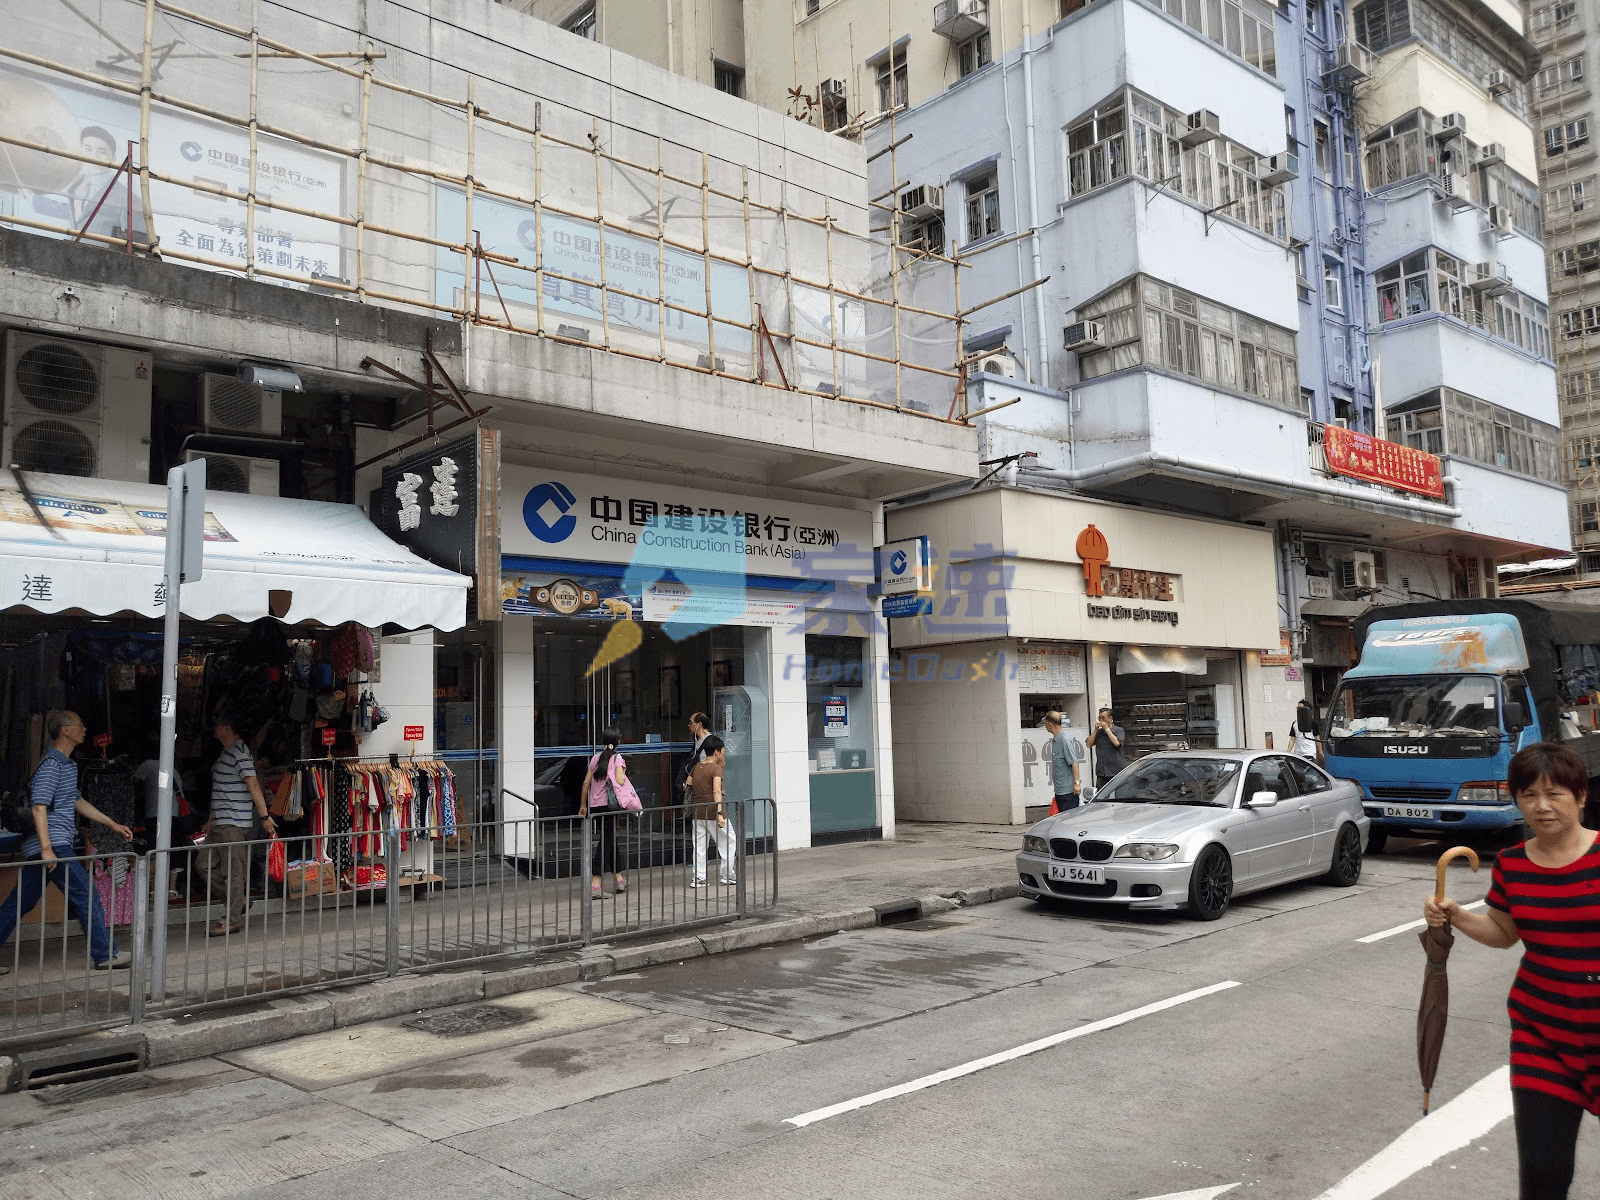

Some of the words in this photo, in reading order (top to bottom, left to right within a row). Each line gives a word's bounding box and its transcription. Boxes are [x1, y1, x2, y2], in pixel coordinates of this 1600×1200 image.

[208, 159, 229, 169] China
[553, 245, 579, 260] China
[591, 525, 637, 545] China
[642, 530, 731, 554] Construction
[1086, 602, 1111, 619] bao
[1111, 605, 1133, 620] dim
[1150, 609, 1179, 627] seng
[1383, 745, 1429, 755] ISUZU
[1387, 808, 1401, 816] DA
[1406, 809, 1430, 818] 802
[1052, 867, 1066, 879] RJ
[1069, 868, 1098, 882] 5641
